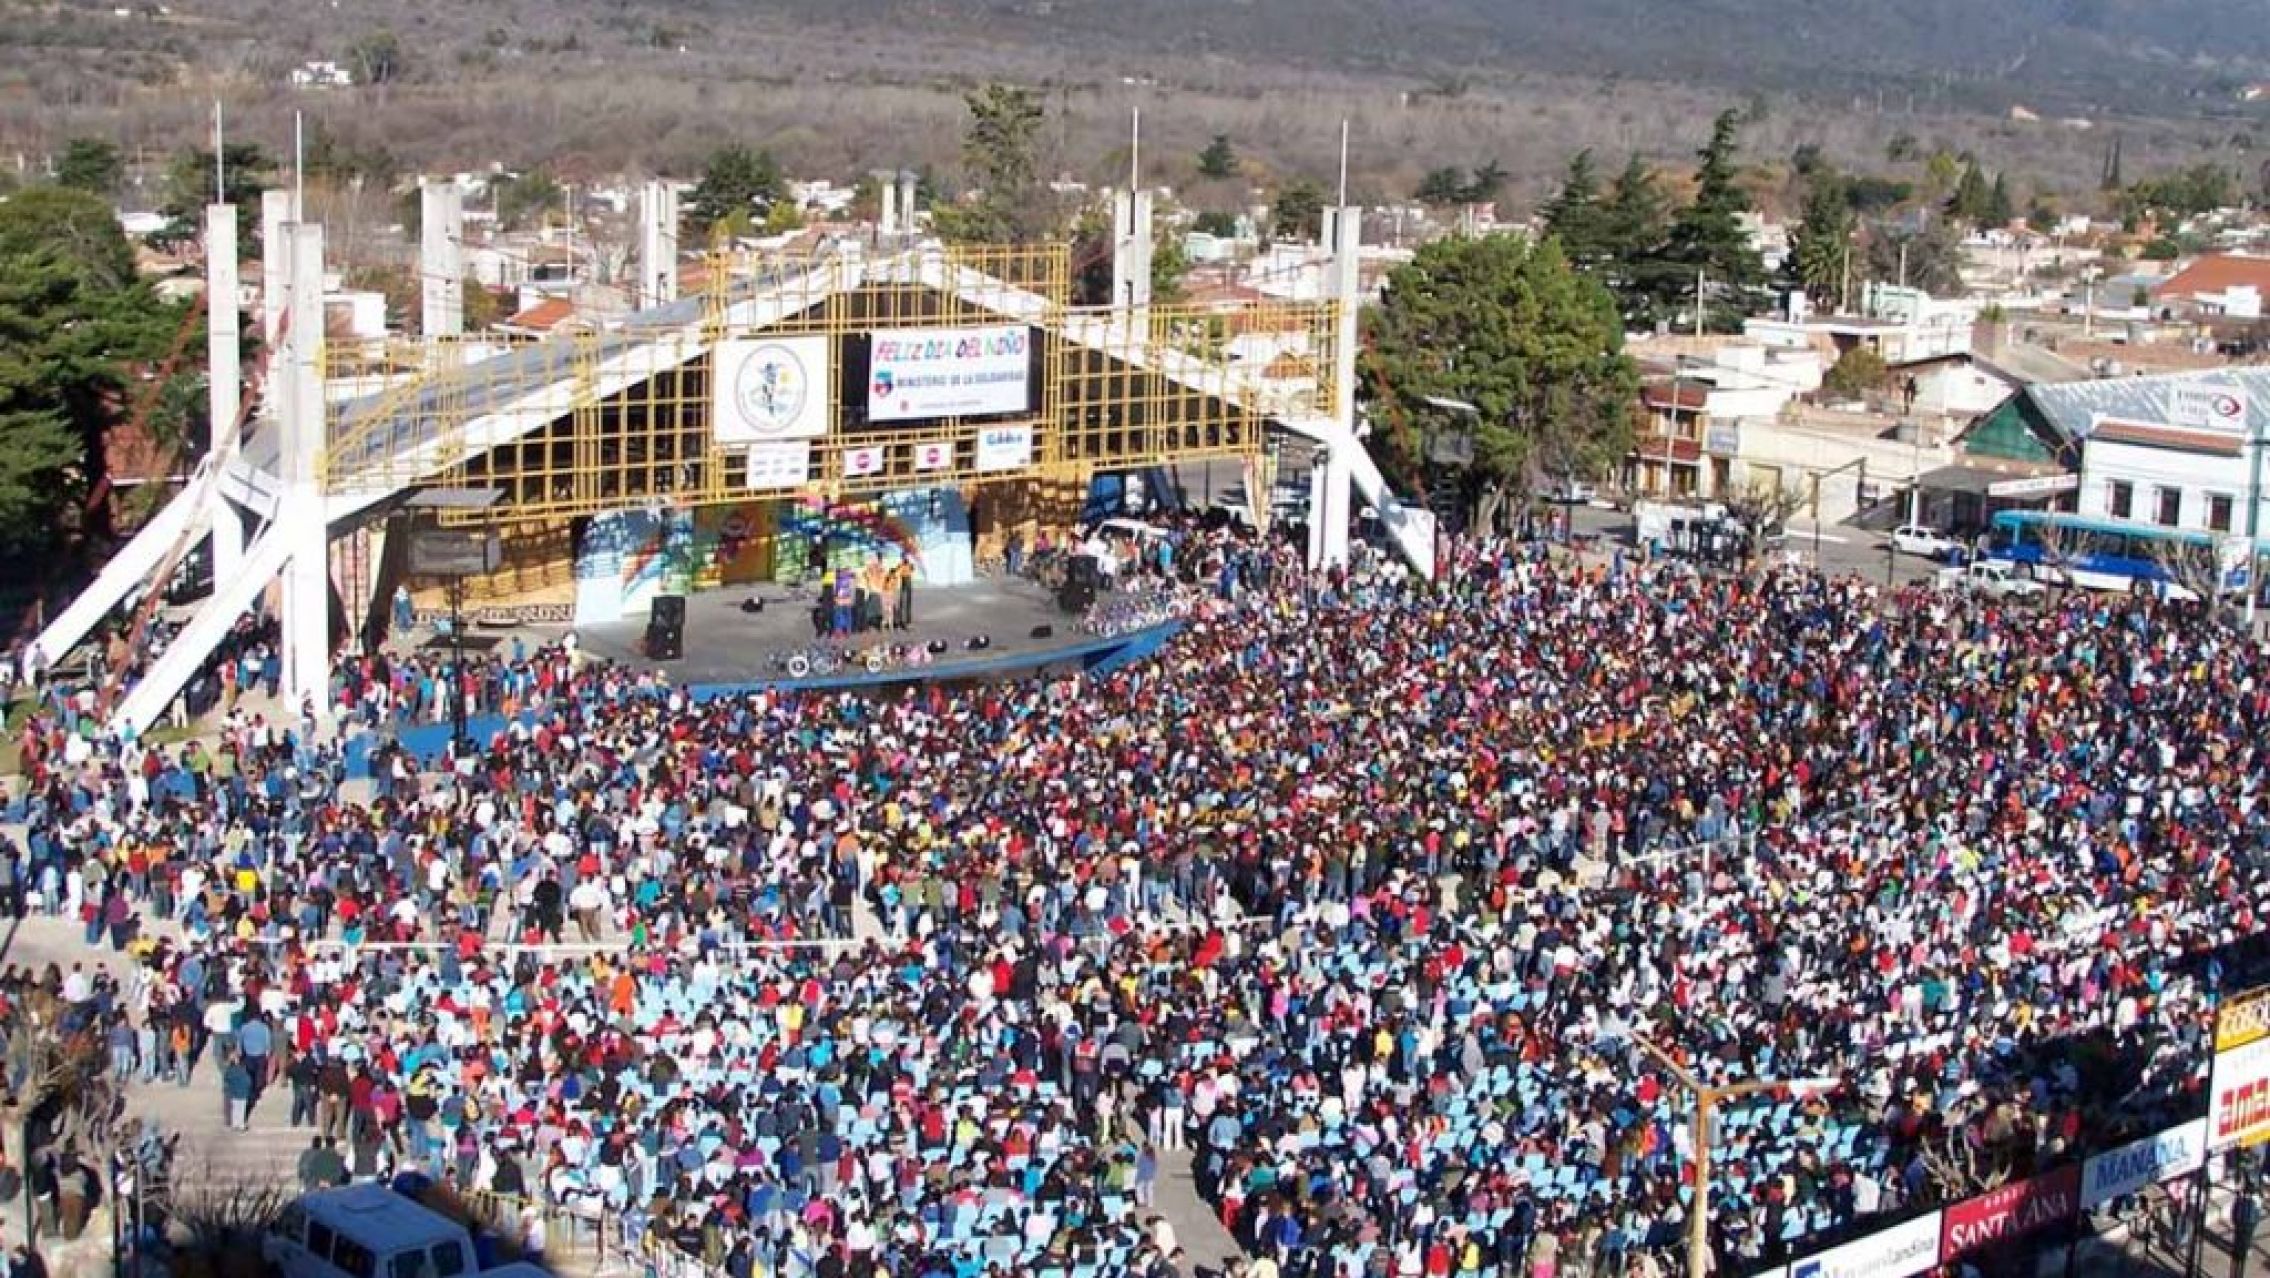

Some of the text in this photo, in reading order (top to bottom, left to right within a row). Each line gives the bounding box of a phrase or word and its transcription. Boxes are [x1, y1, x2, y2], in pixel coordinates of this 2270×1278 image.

[875, 340, 923, 362] FELIZ
[956, 336, 981, 358] DEL
[983, 329, 1025, 357] NIÑO
[897, 374, 946, 388] MINISTERIO
[950, 373, 961, 386] DE
[962, 373, 973, 385] LA
